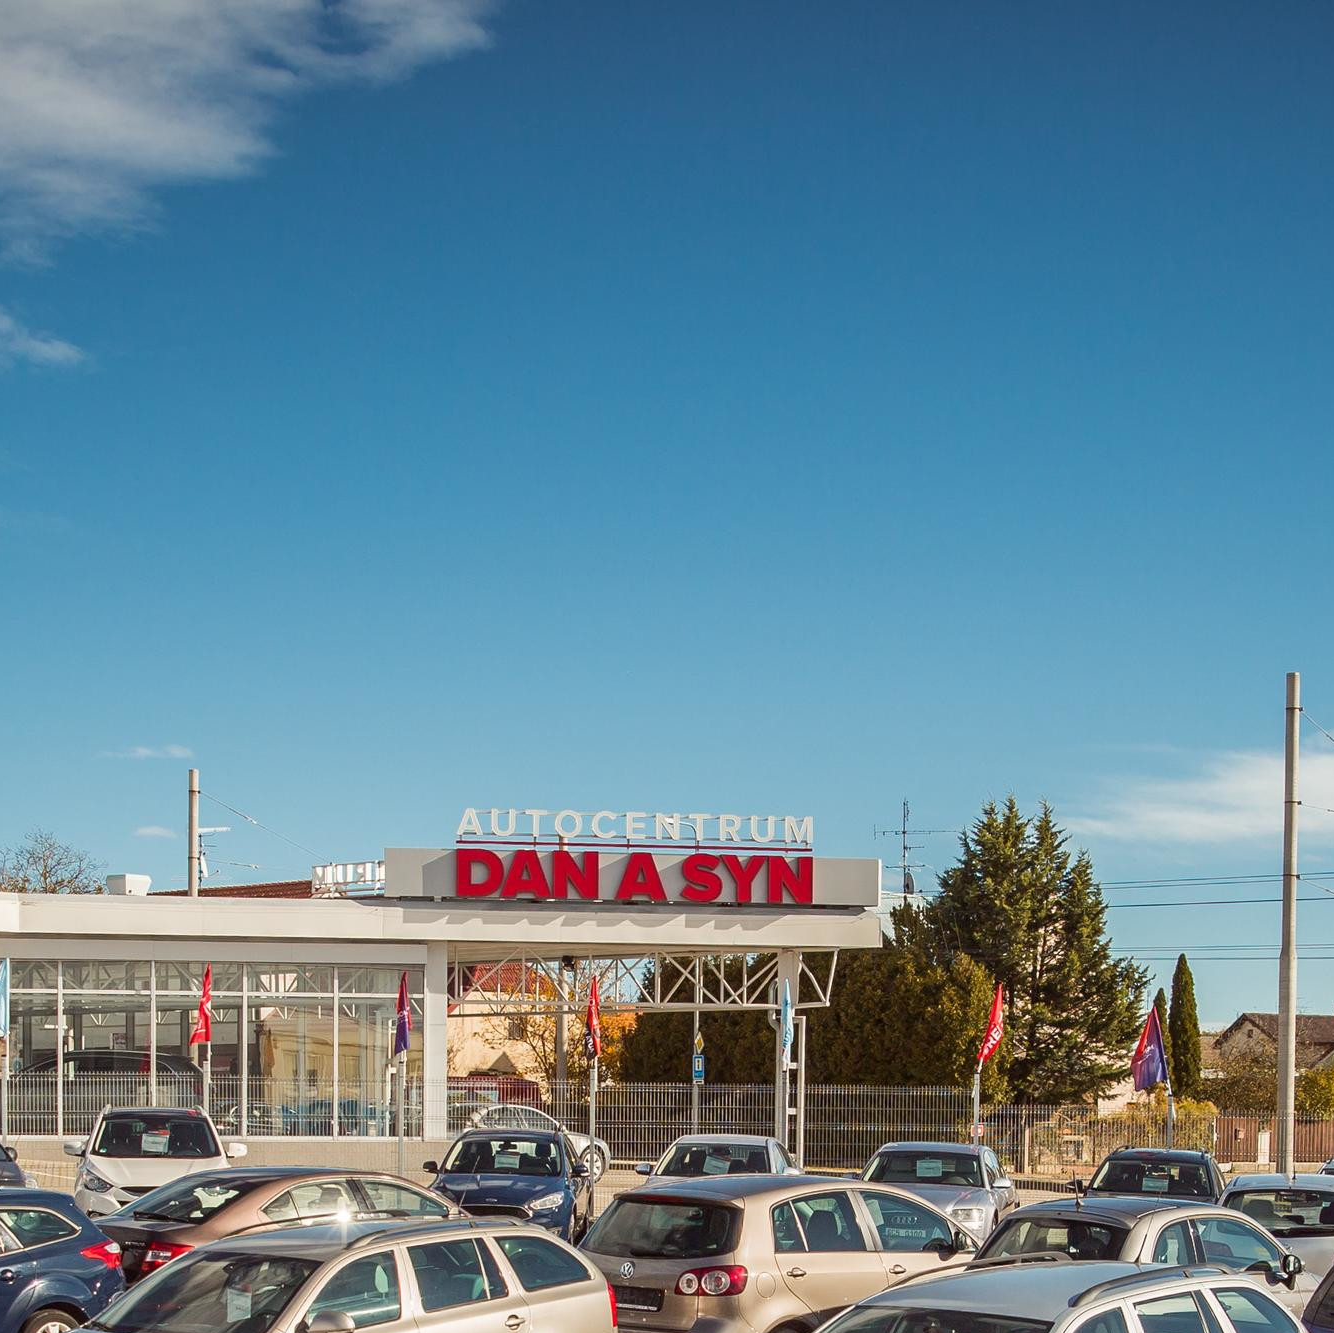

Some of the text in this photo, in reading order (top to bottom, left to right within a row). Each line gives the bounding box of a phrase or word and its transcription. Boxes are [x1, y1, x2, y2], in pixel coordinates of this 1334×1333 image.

[456, 808, 814, 844] AUTOCENTRUM
[455, 848, 814, 905] DAN A SYN
